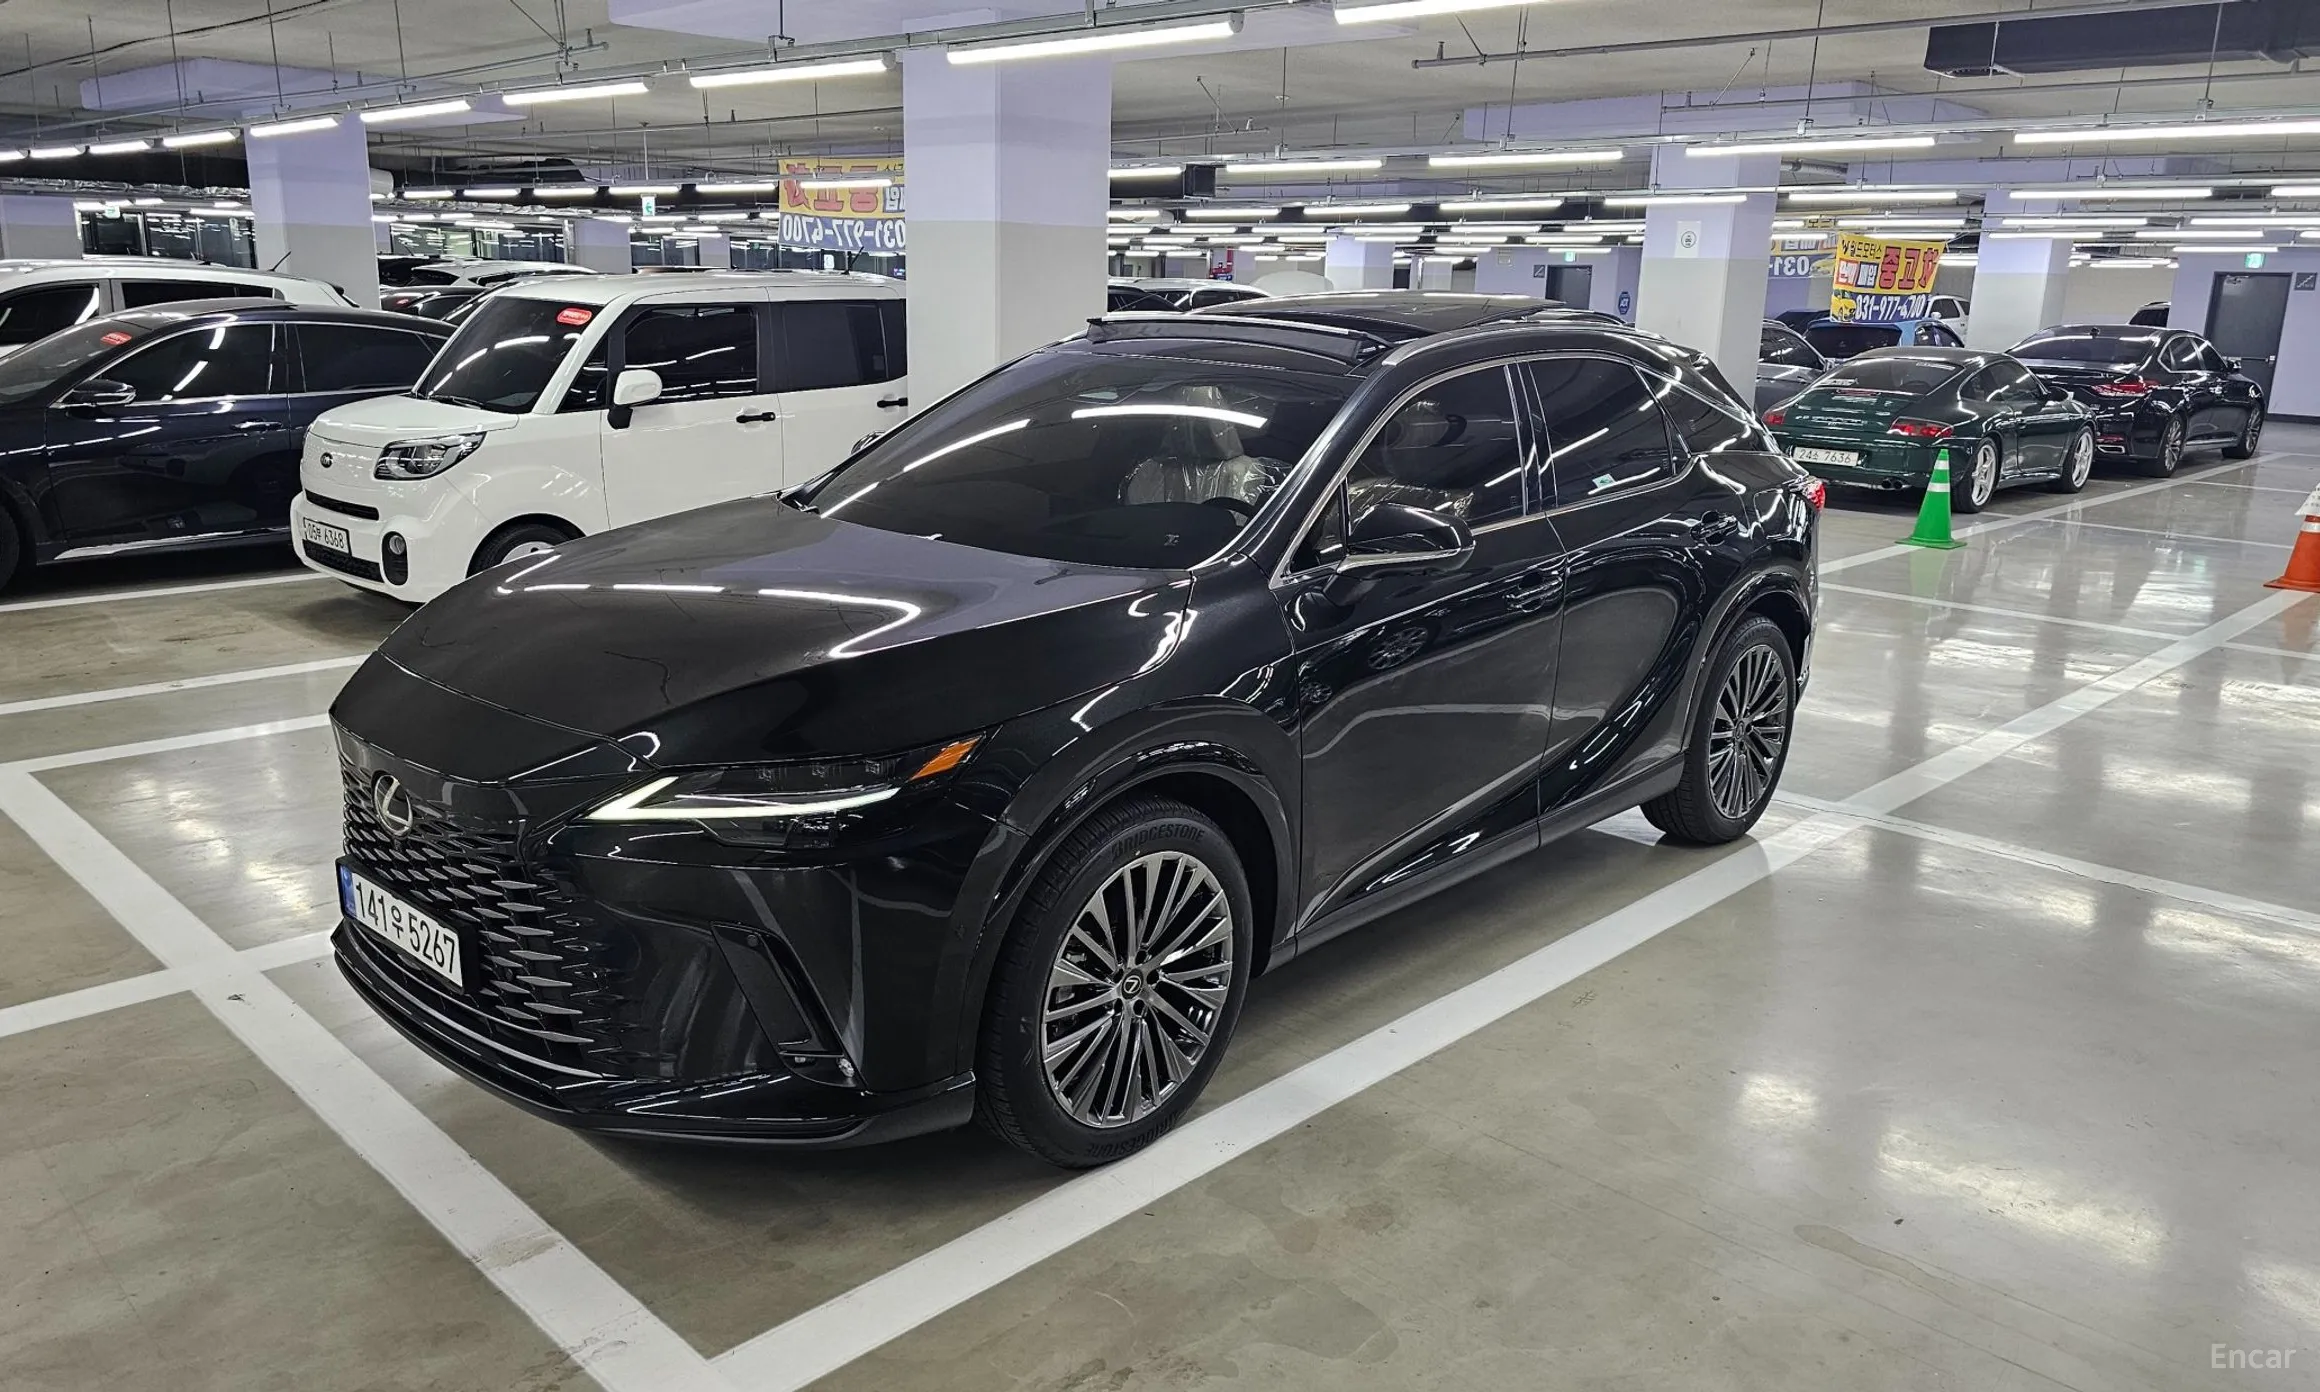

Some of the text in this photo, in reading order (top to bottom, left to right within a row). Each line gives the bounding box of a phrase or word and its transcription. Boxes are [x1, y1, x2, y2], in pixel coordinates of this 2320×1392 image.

[1879, 245, 1939, 290] 중고차
[1824, 451, 1851, 464] 7636
[356, 882, 456, 974] 141우 5267
